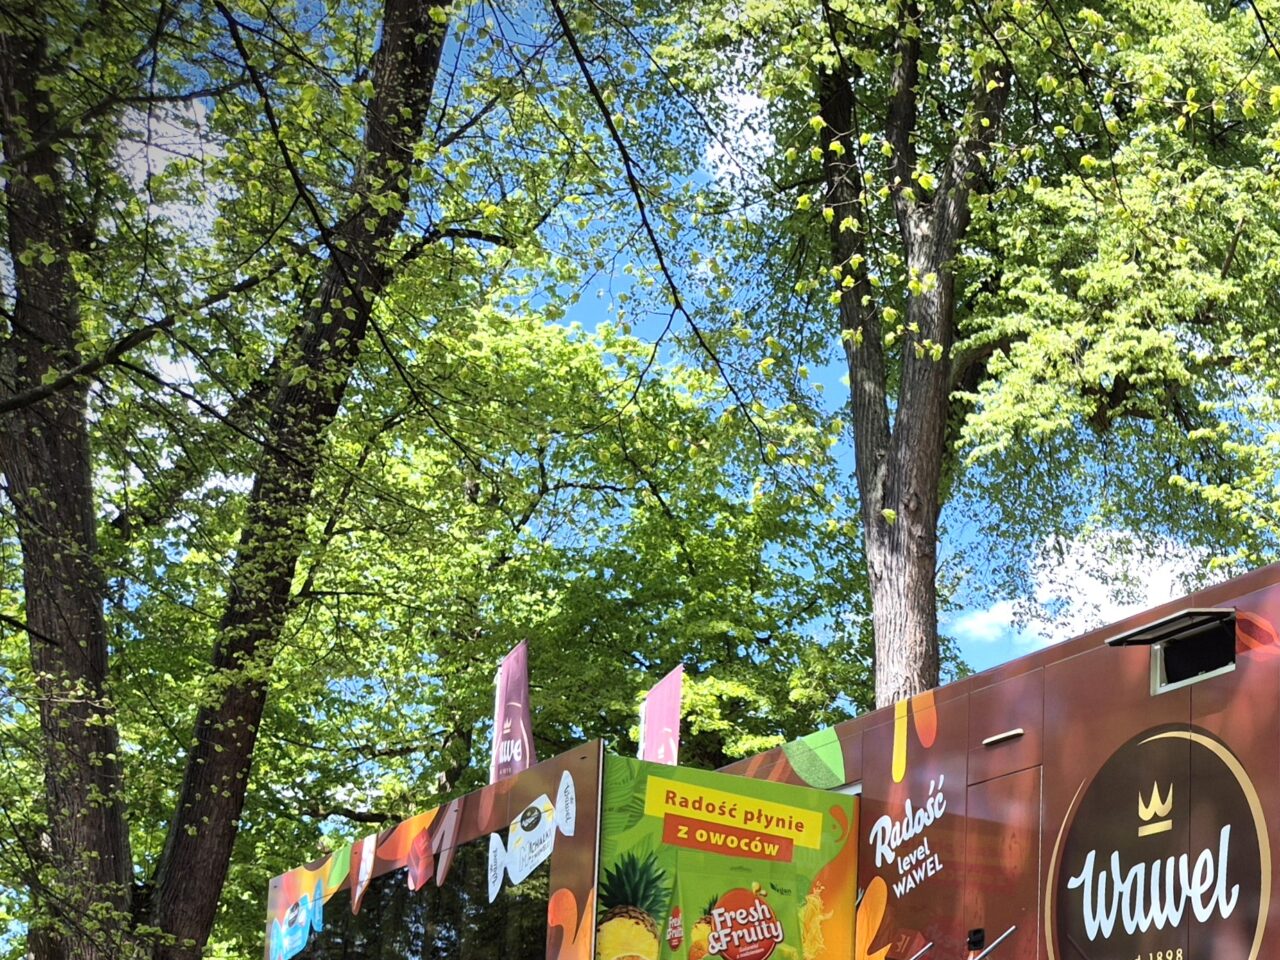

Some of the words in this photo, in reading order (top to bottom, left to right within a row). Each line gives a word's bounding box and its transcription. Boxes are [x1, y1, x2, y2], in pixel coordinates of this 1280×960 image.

[665, 790, 737, 818] Radość
[743, 808, 805, 833] płynie
[869, 774, 946, 868] Radość
[677, 825, 689, 839] z
[695, 829, 779, 856] owoców
[897, 837, 930, 875] level
[892, 853, 943, 899] WAWEL
[1067, 823, 1240, 941] Wawel
[711, 899, 771, 931] Fresh
